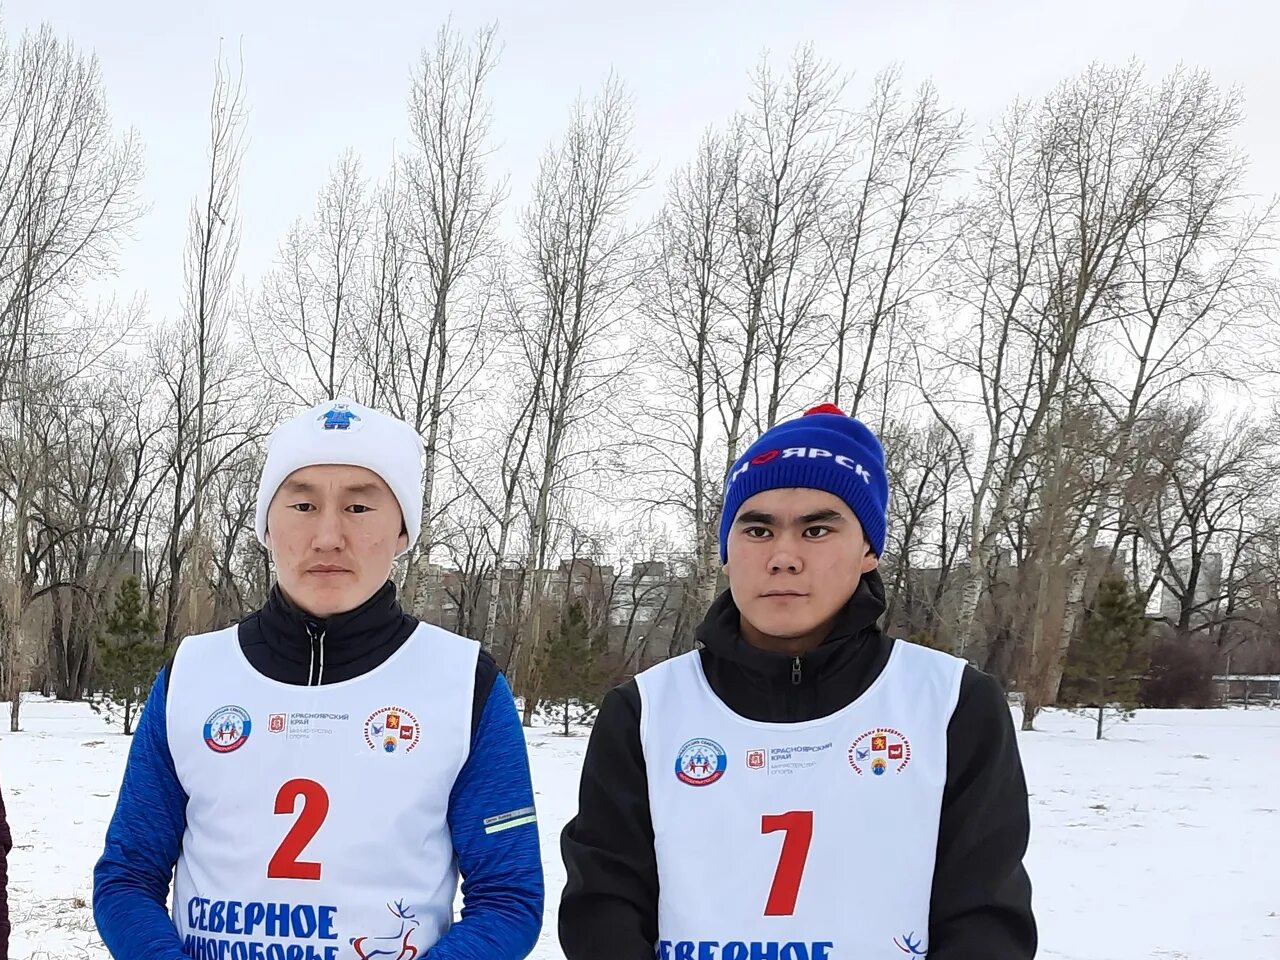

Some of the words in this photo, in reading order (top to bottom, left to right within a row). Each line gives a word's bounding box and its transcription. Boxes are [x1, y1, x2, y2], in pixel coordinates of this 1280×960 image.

[268, 778, 329, 880] 2
[761, 810, 813, 916] 7
[188, 896, 339, 940] СЕВЕРНОЕ
